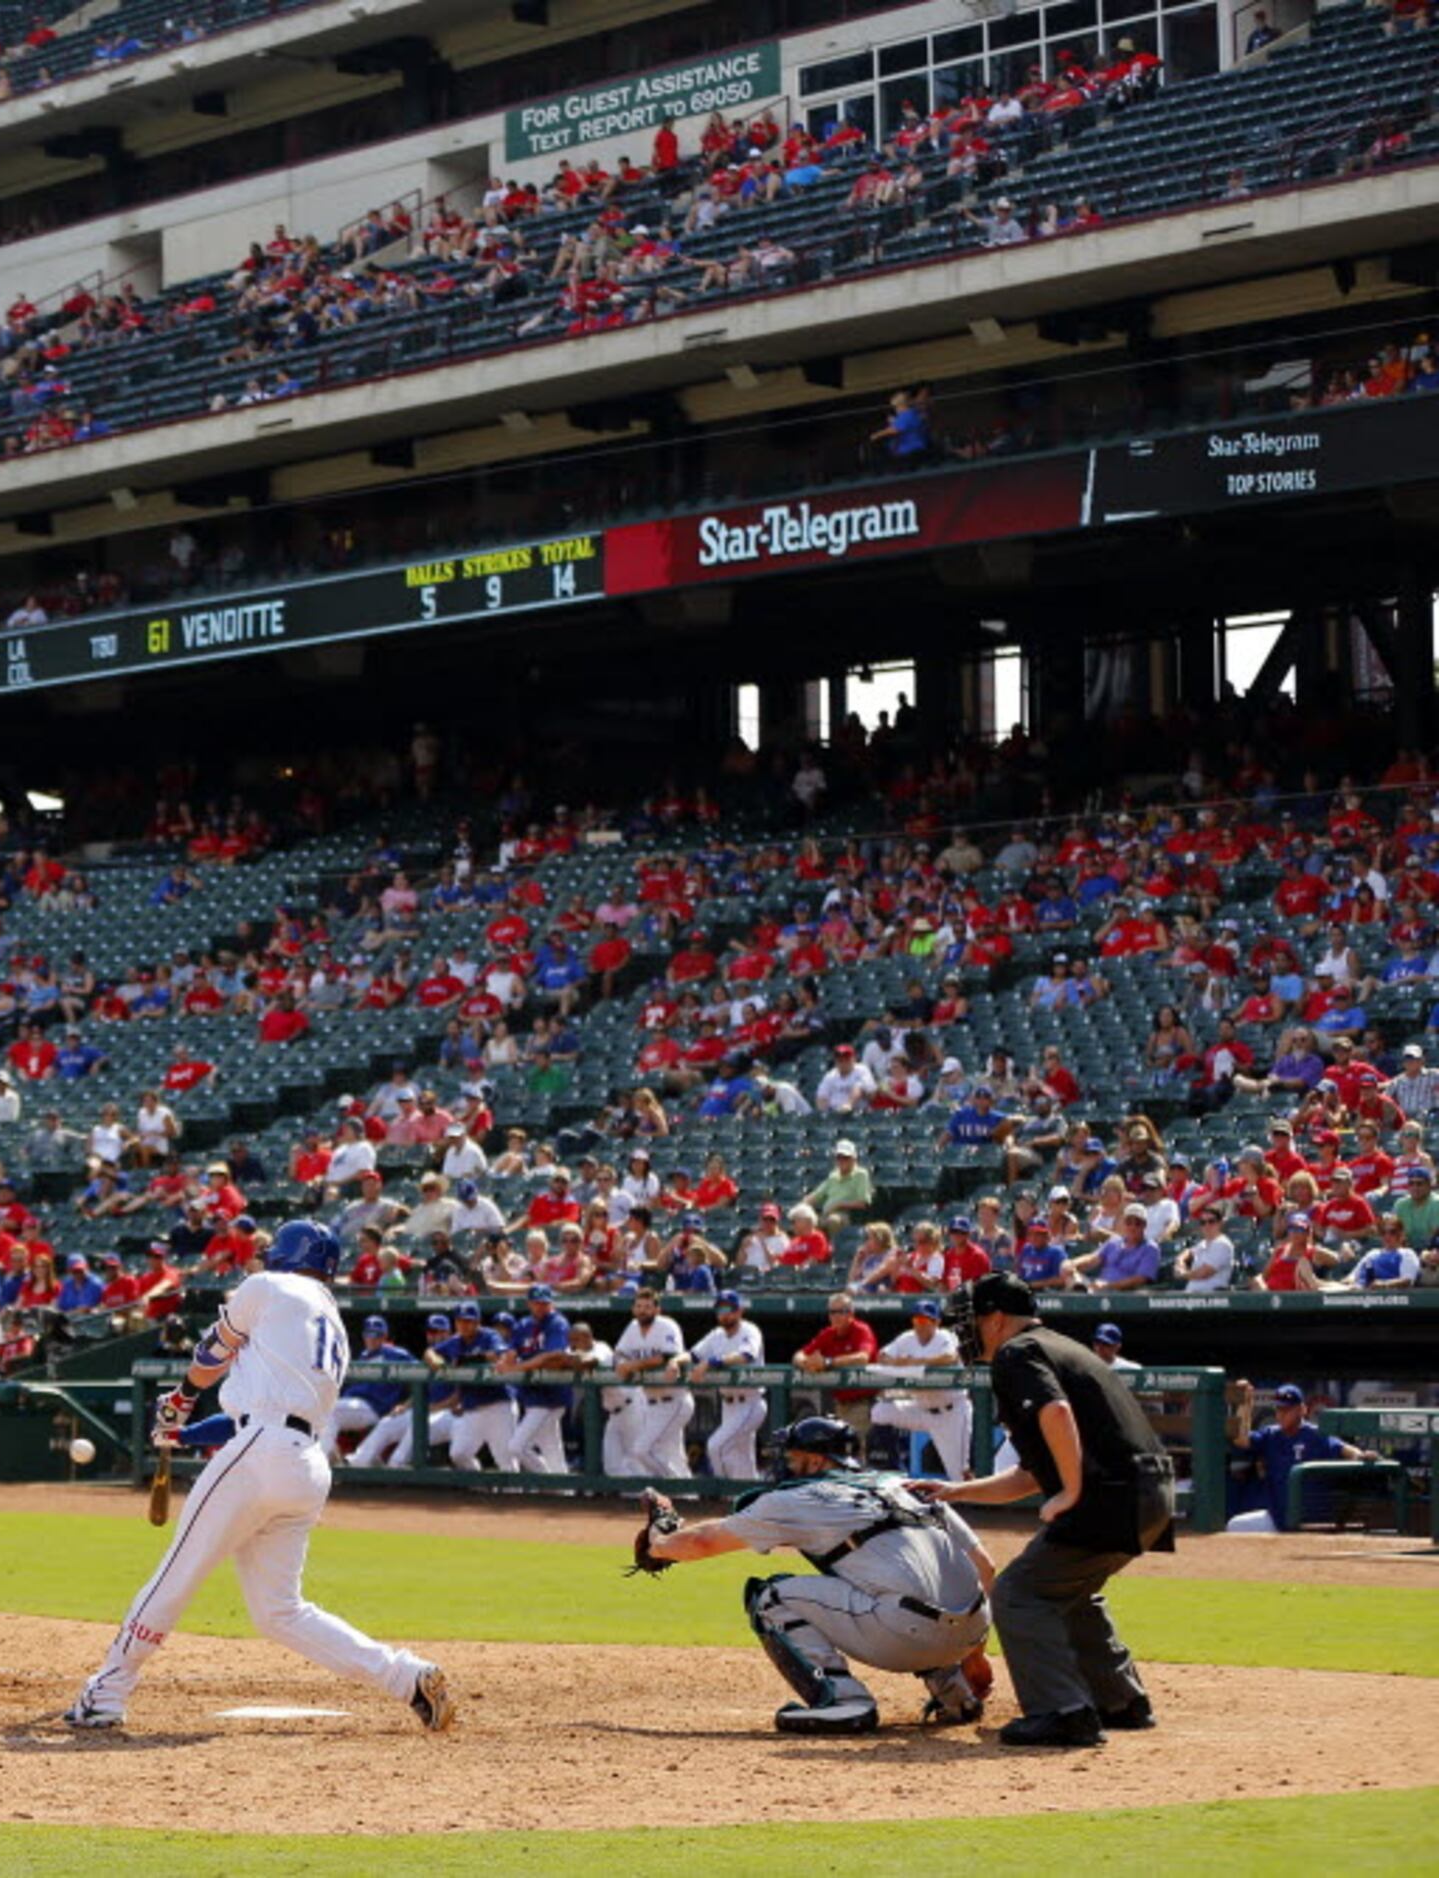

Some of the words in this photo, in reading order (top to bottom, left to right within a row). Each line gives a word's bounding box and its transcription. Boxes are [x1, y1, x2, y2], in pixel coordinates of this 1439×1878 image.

[522, 105, 560, 132] FOR
[565, 86, 631, 119] GUEST
[635, 53, 761, 101] ASSISTANCE
[528, 129, 572, 153] TEXT
[578, 107, 658, 142] REPORT
[690, 81, 752, 112] 69050
[1208, 432, 1320, 457] Star-Telegram
[1227, 473, 1253, 495] TOP
[1257, 469, 1317, 493] STORIES
[698, 499, 920, 566] Star-Telegram
[406, 561, 455, 587] BALLS
[463, 548, 532, 578] STRIKES
[540, 536, 595, 566] TOTAL
[421, 586, 437, 620] 5
[486, 575, 502, 609] 9
[552, 563, 576, 598] 14
[147, 619, 170, 653] 61
[181, 600, 285, 649] VENDITTE
